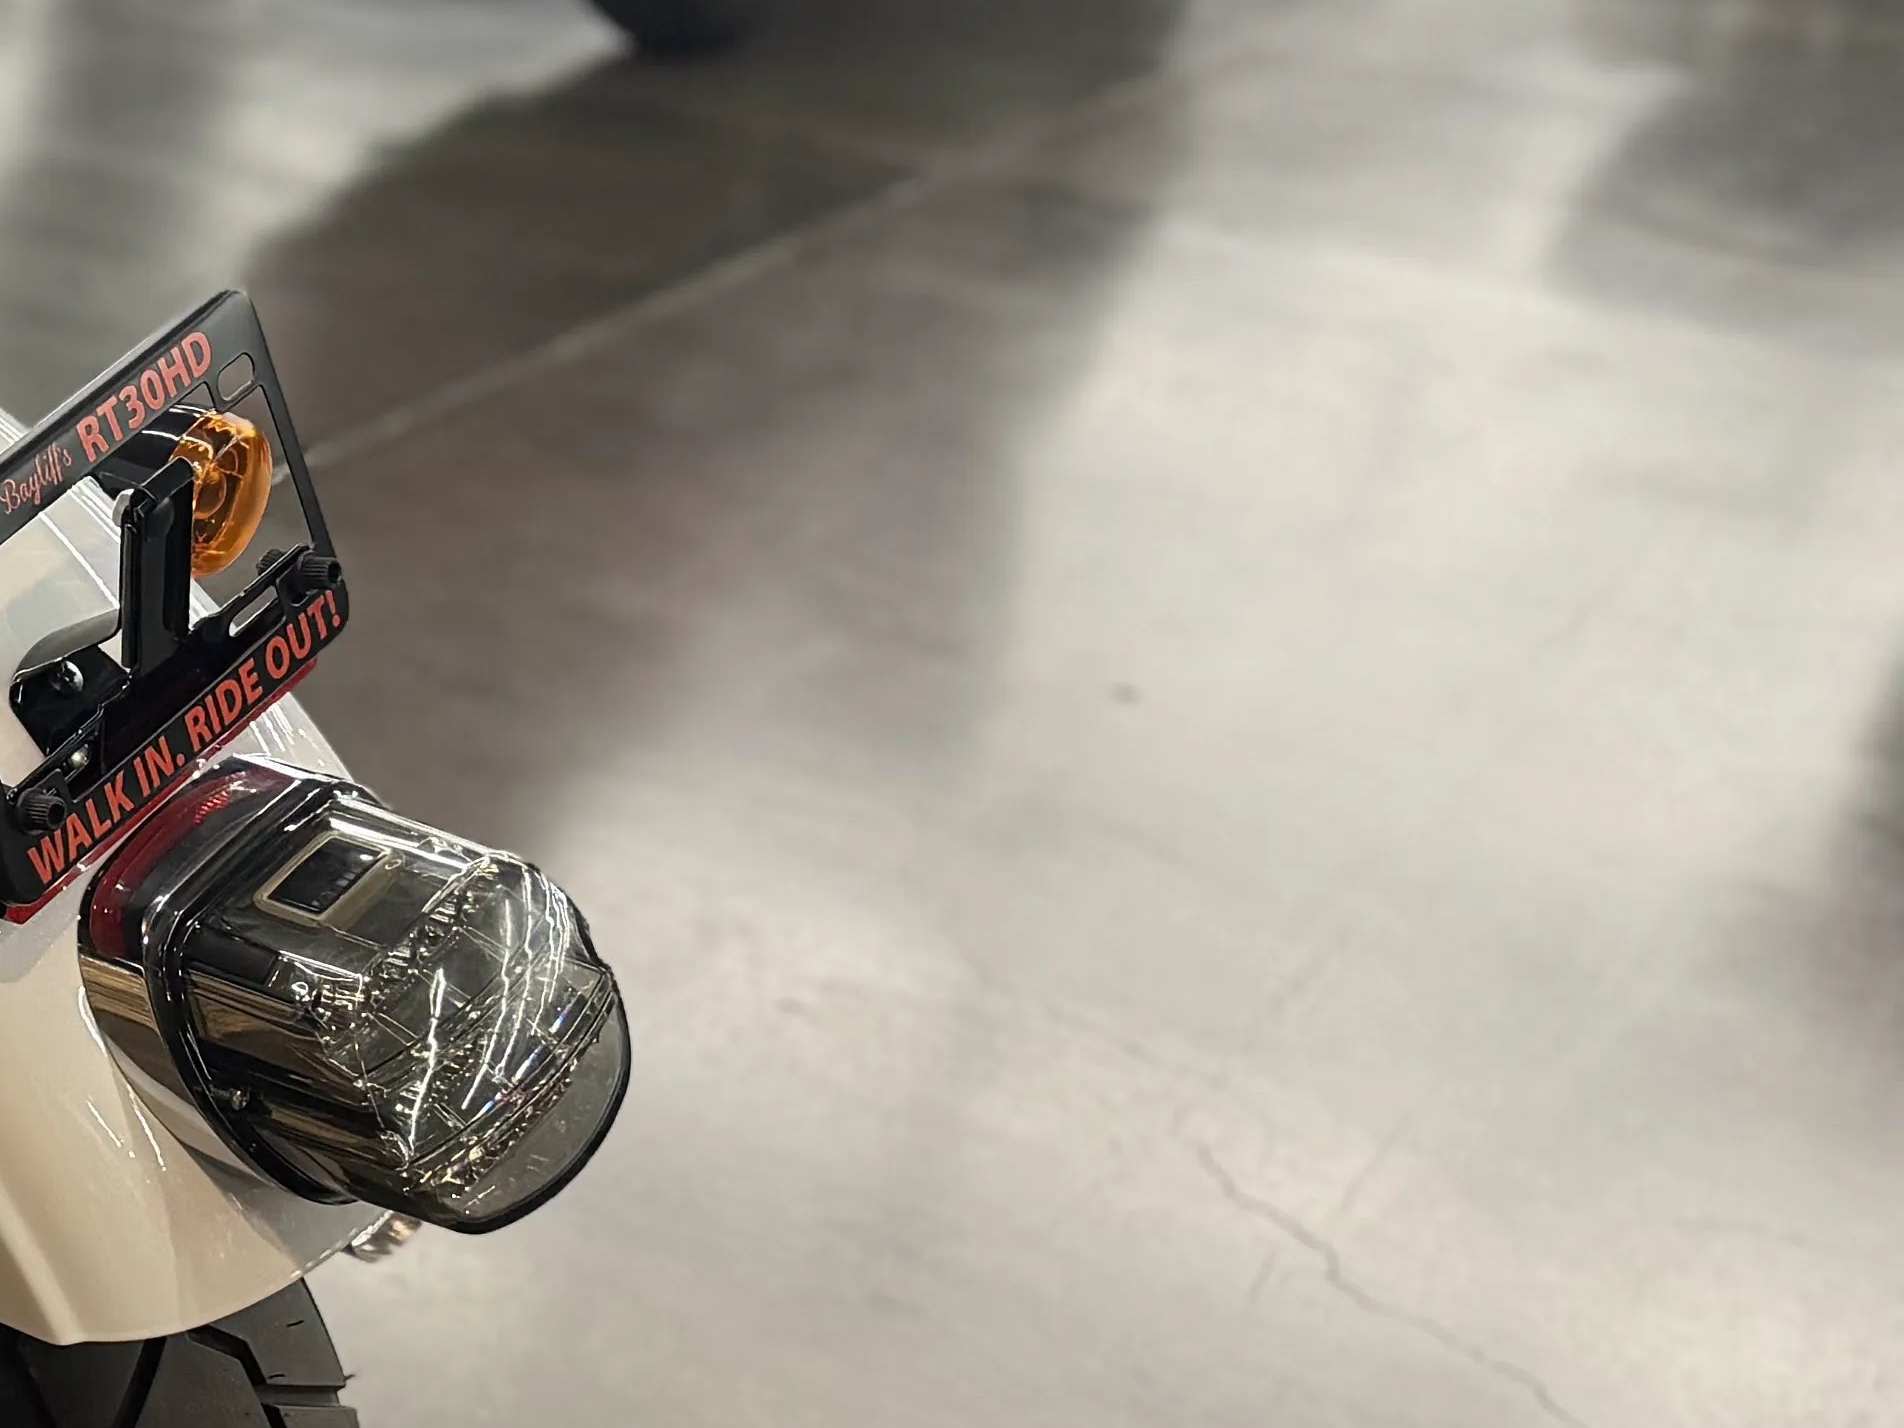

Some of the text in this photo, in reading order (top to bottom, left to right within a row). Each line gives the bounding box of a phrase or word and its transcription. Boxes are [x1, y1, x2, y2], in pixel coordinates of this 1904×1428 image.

[76, 331, 212, 462] RT30HD
[27, 590, 341, 884] WALK IN. RIDE OUT!
